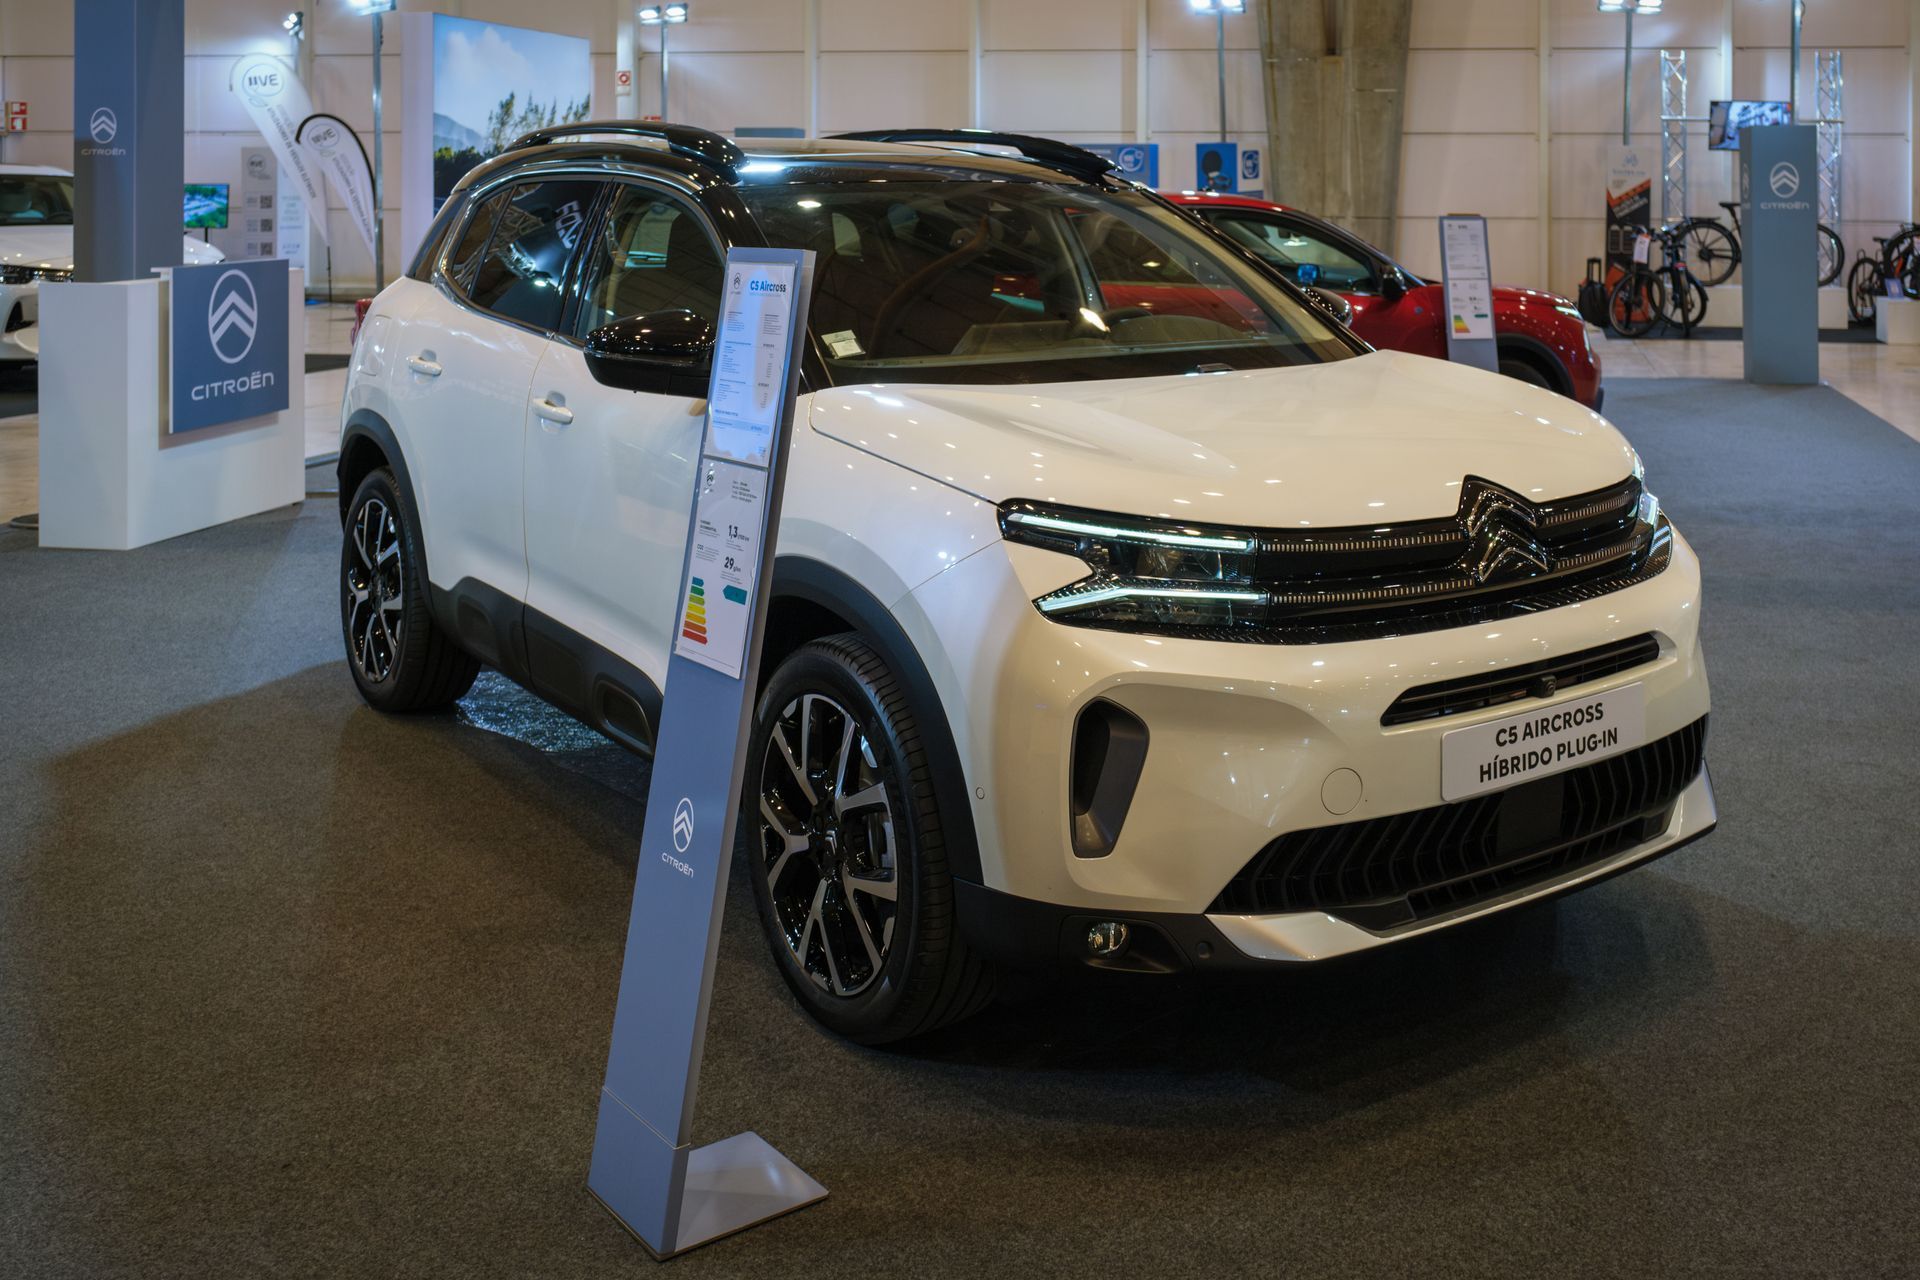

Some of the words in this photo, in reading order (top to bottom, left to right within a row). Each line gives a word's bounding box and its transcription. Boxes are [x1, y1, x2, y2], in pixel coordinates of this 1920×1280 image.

[750, 280, 760, 291] C5
[760, 280, 787, 293] Aircross
[728, 524, 739, 540] 1,3
[724, 556, 735, 570] 29
[1495, 726, 1518, 747] C5
[1522, 702, 1604, 741] AIRCROSS
[1479, 746, 1553, 783] HÍBRIDO
[1556, 728, 1618, 762] PLUG-IN
